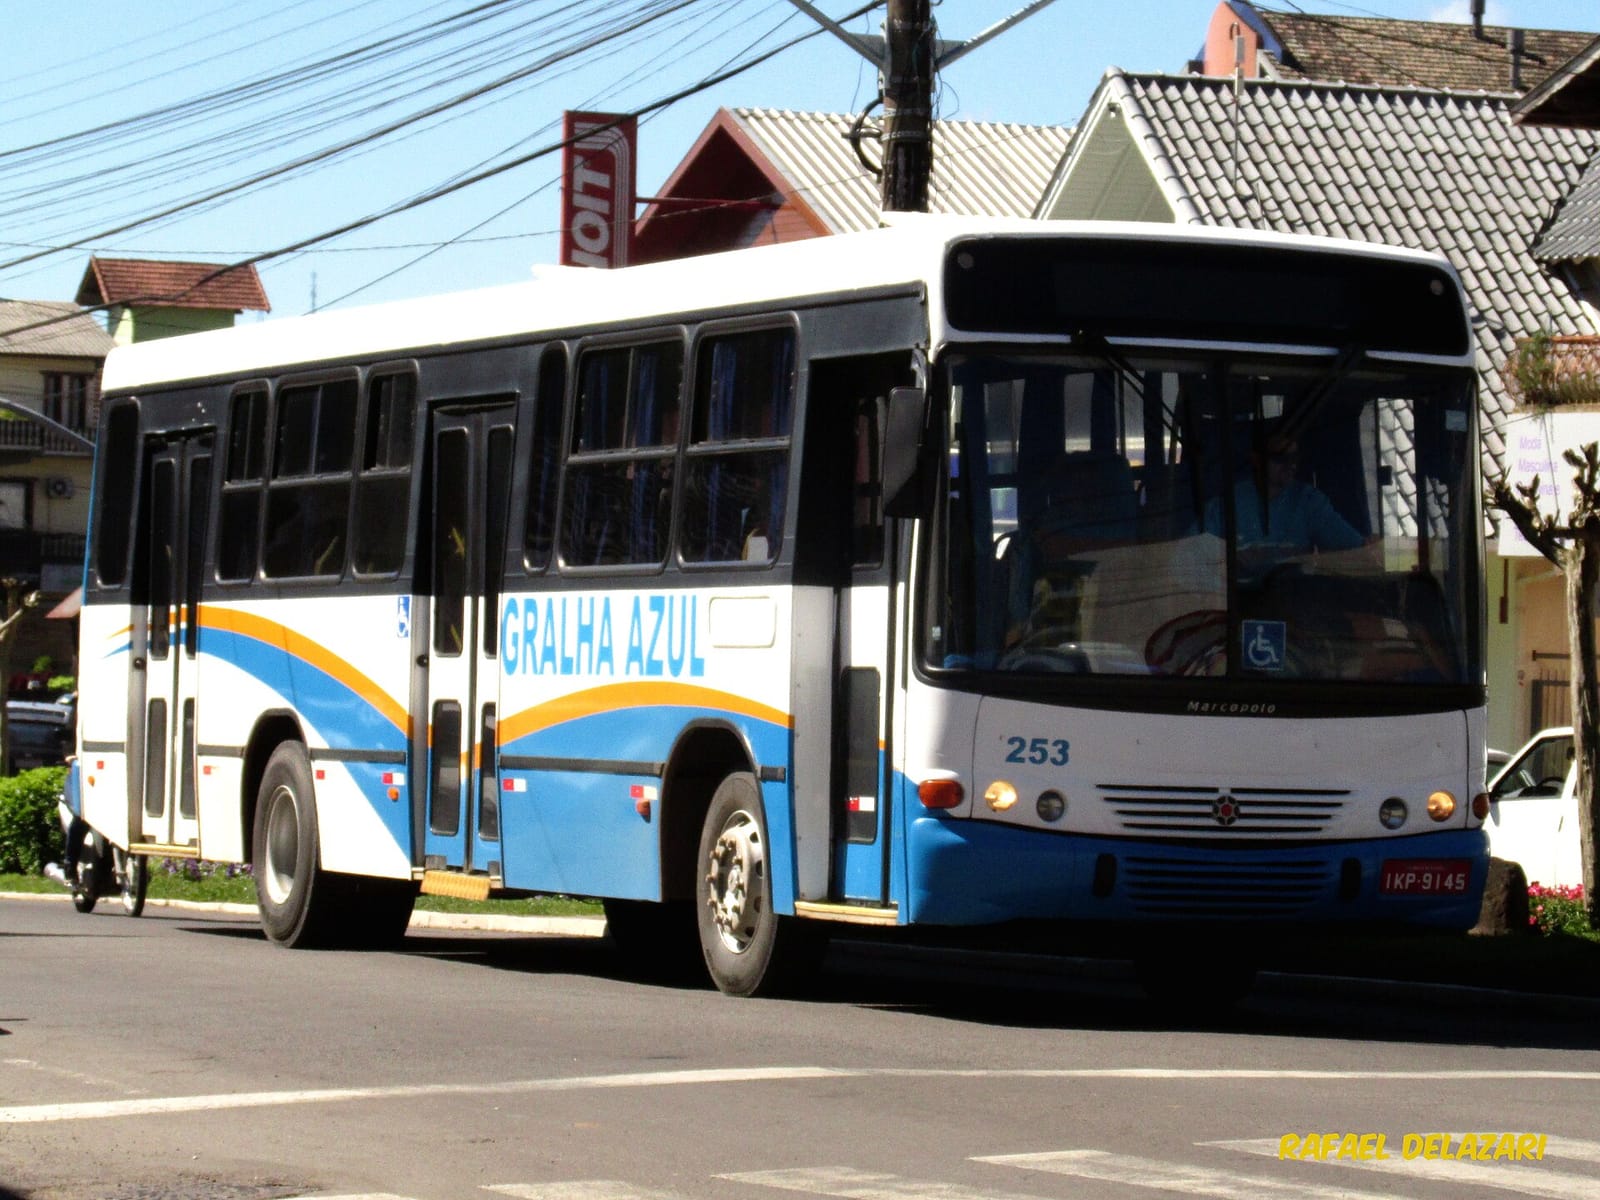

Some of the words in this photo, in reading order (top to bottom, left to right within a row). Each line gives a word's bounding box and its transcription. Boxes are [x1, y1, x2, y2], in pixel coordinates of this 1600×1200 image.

[501, 596, 614, 676] GRALHA
[625, 595, 705, 677] AZUL
[1187, 700, 1276, 714] Marcopolo
[1005, 736, 1070, 766] 253
